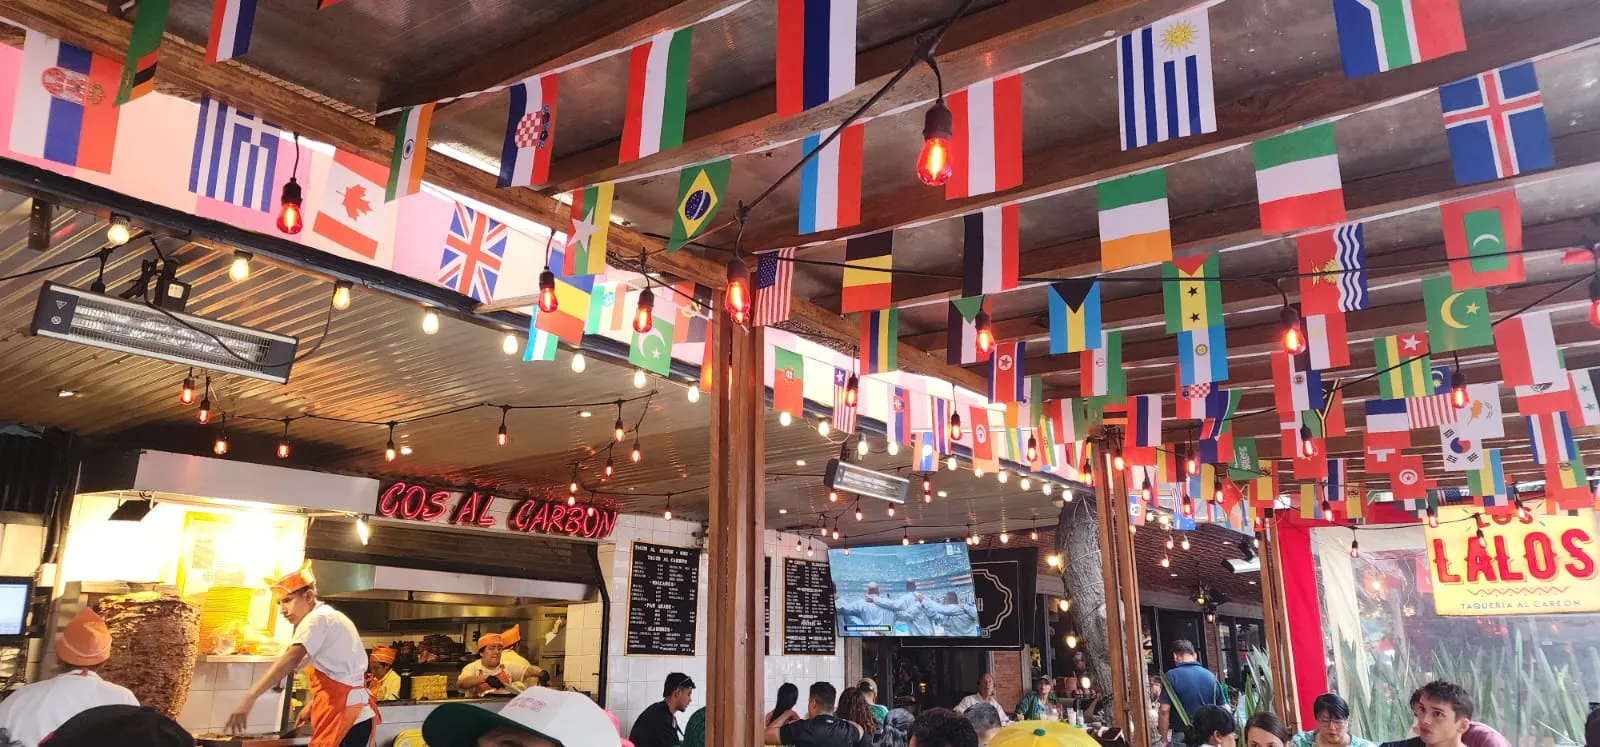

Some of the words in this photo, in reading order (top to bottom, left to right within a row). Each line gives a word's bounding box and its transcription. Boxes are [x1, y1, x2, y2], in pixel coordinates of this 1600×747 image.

[456, 492, 496, 525] AL
[516, 500, 617, 538] CARBON
[1476, 507, 1533, 528] LOS
[1433, 528, 1594, 583] LALOS
